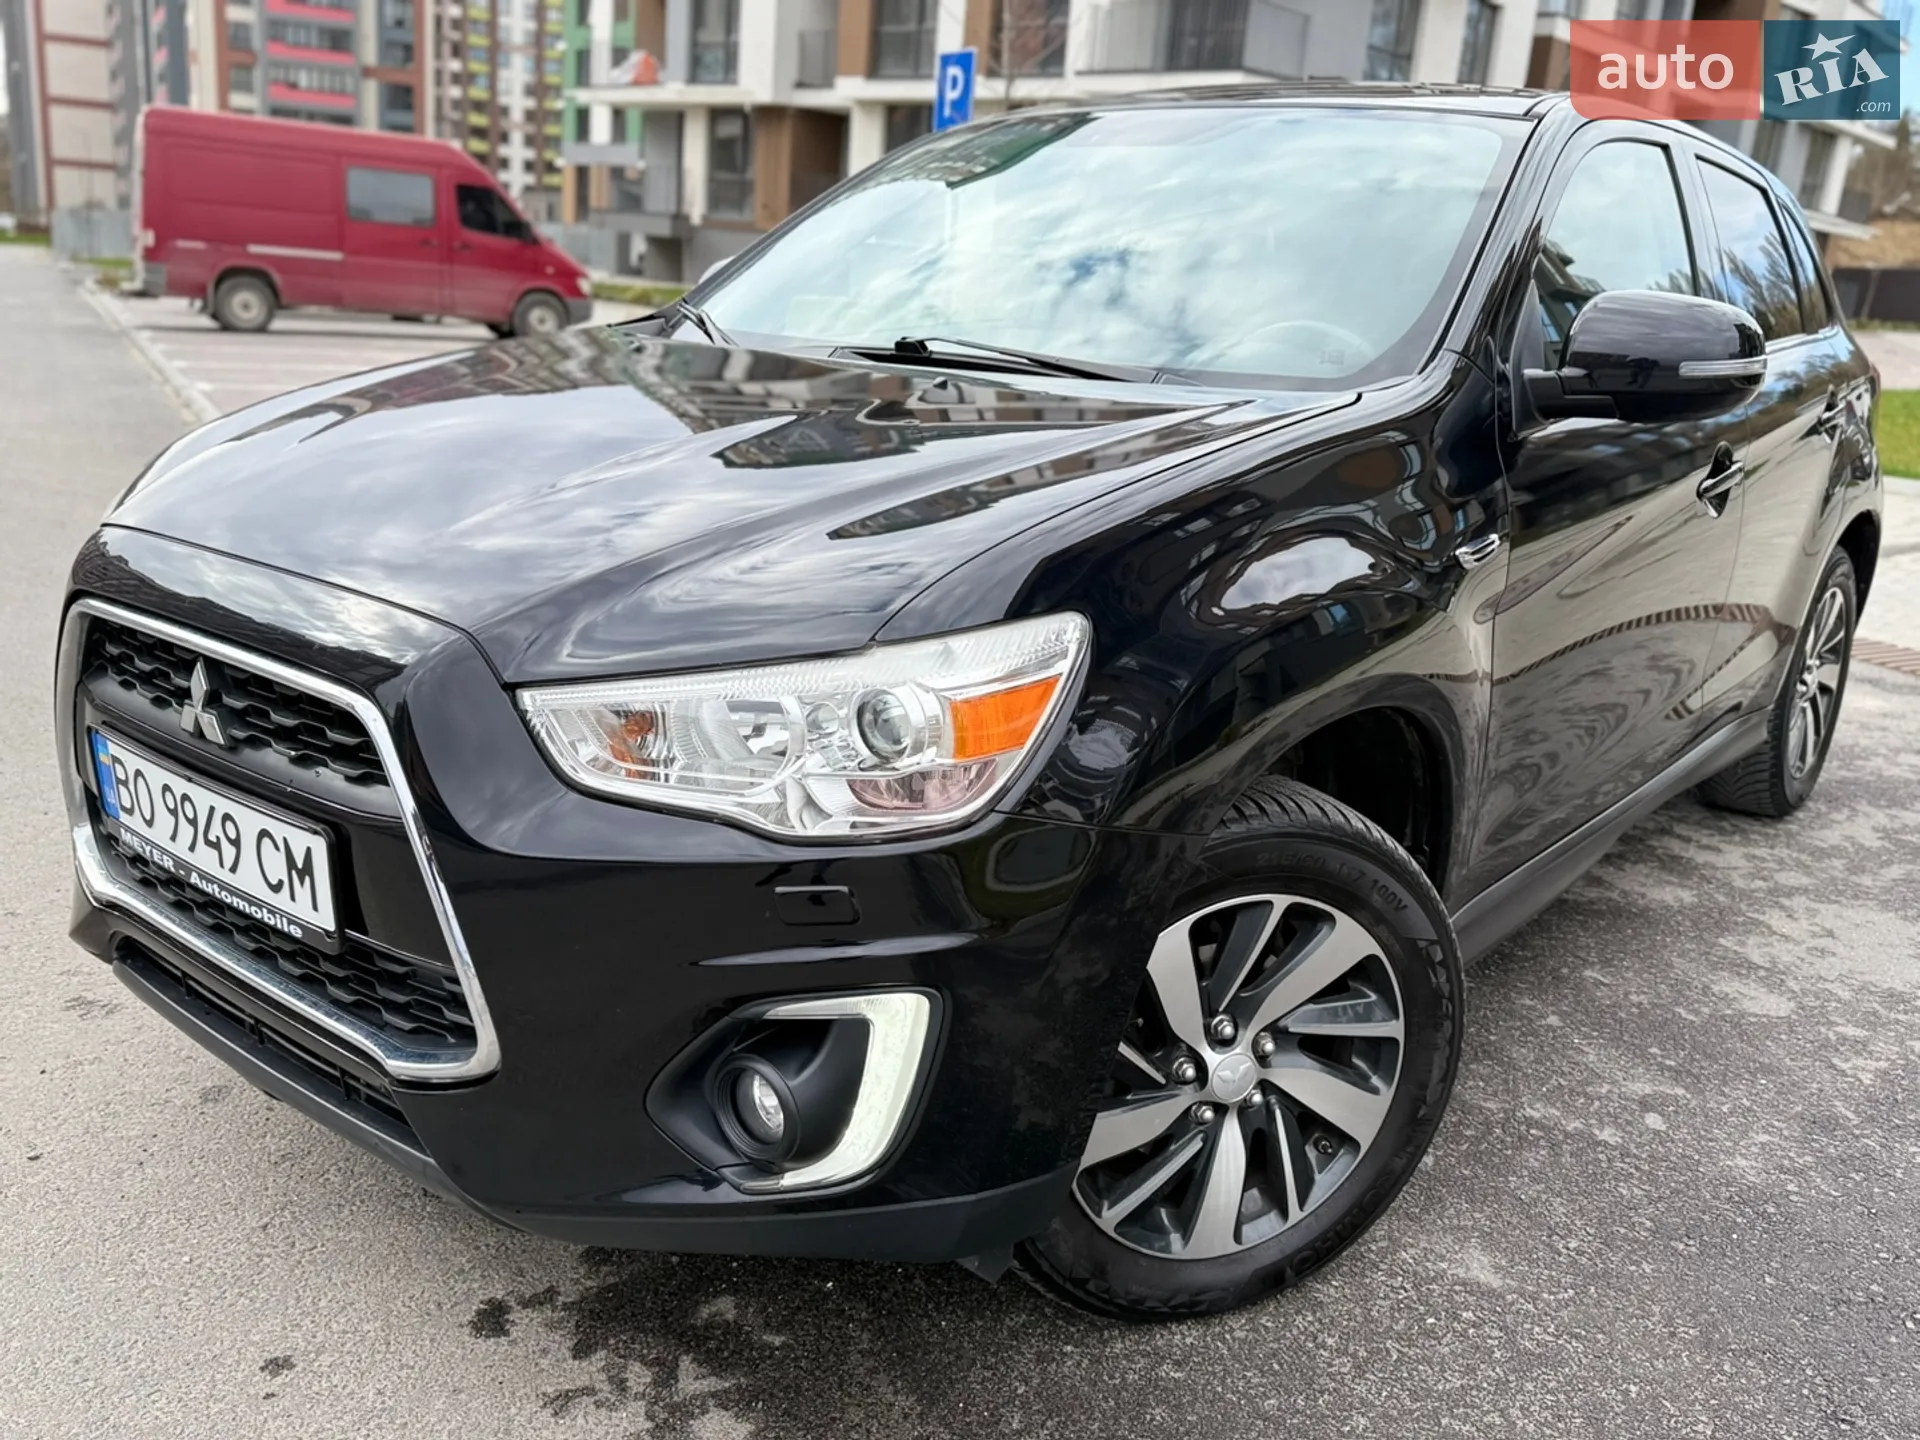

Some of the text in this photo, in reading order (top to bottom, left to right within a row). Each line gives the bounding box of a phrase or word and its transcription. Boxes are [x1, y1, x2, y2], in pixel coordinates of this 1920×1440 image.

[943, 65, 965, 119] P
[111, 753, 319, 912] BO 9949 CM
[119, 828, 175, 872] MEYER
[190, 870, 303, 938] Automobile
[1370, 879, 1409, 912] 100V
